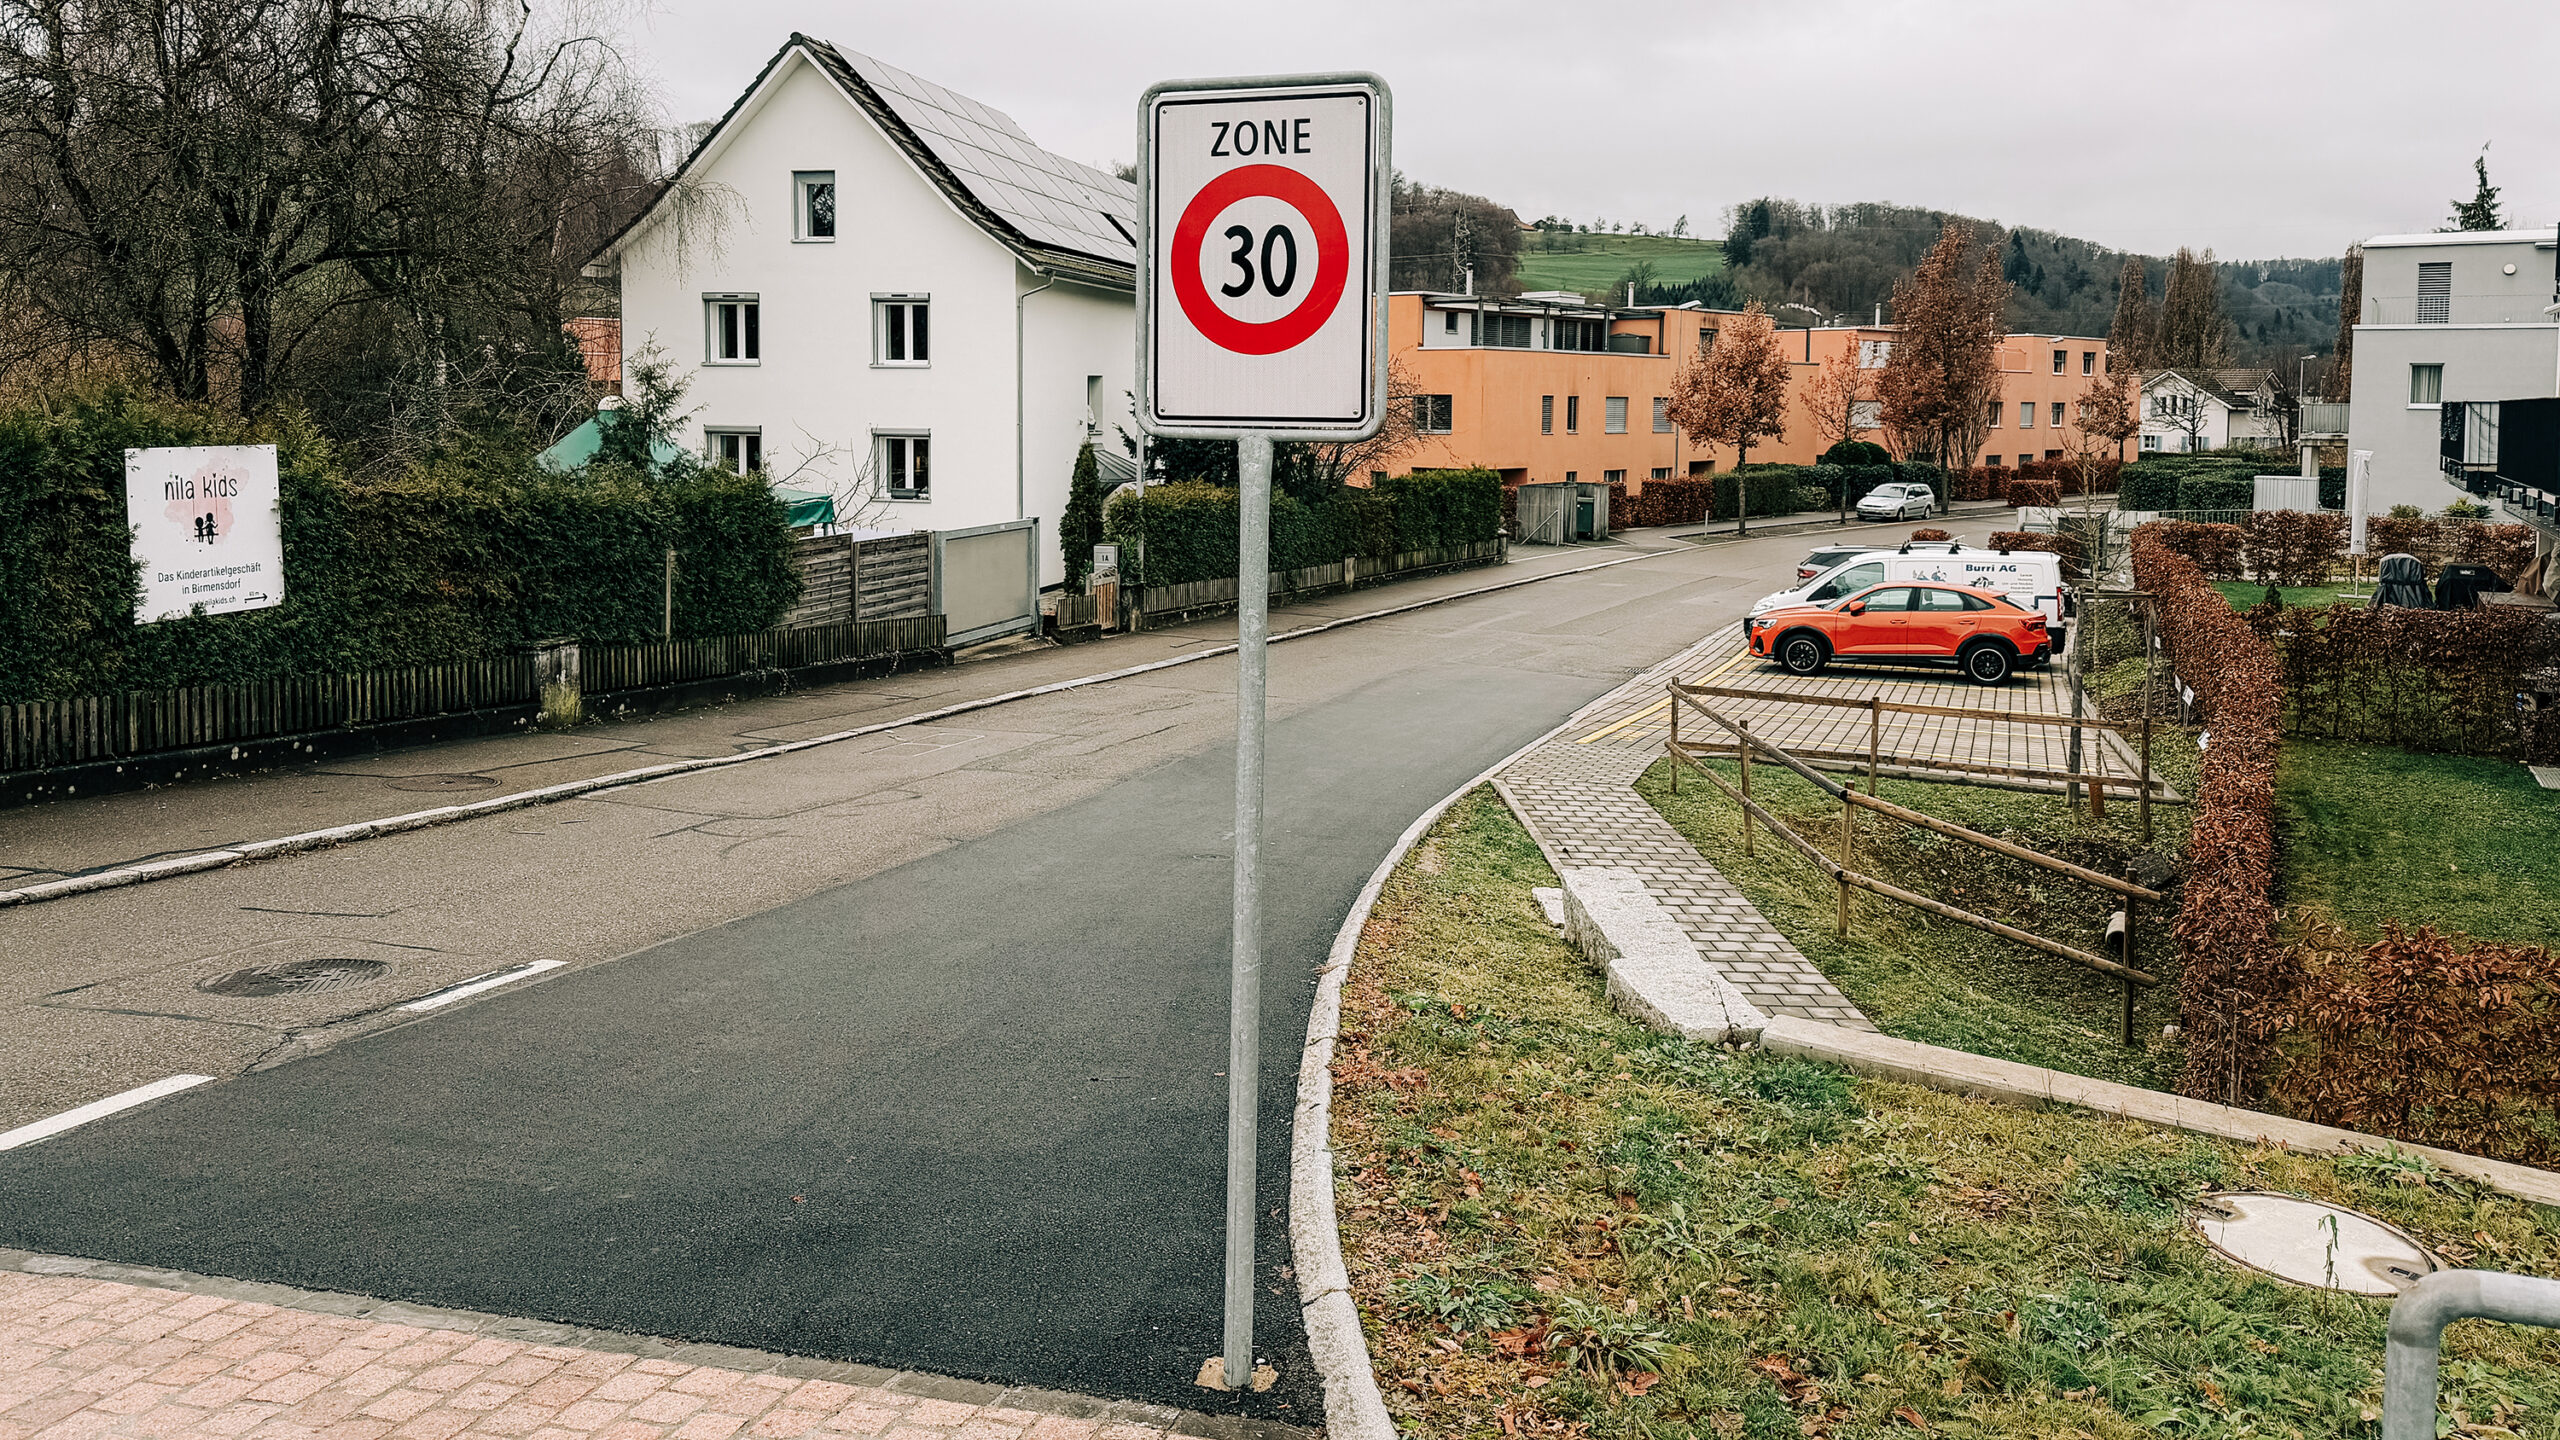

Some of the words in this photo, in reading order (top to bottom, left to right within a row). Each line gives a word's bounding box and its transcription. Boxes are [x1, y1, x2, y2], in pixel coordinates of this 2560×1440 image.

[1210, 117, 1311, 158] ZONE
[1220, 223, 1298, 298] 30
[164, 474, 195, 500] nila
[202, 472, 238, 498] kids
[157, 572, 174, 583] Das
[176, 562, 262, 580] Kinderartikelgeschäft
[1965, 564, 1995, 572] Burri
[1998, 564, 2017, 573] AG
[181, 585, 190, 594] in
[191, 578, 241, 594] Birmensdorf
